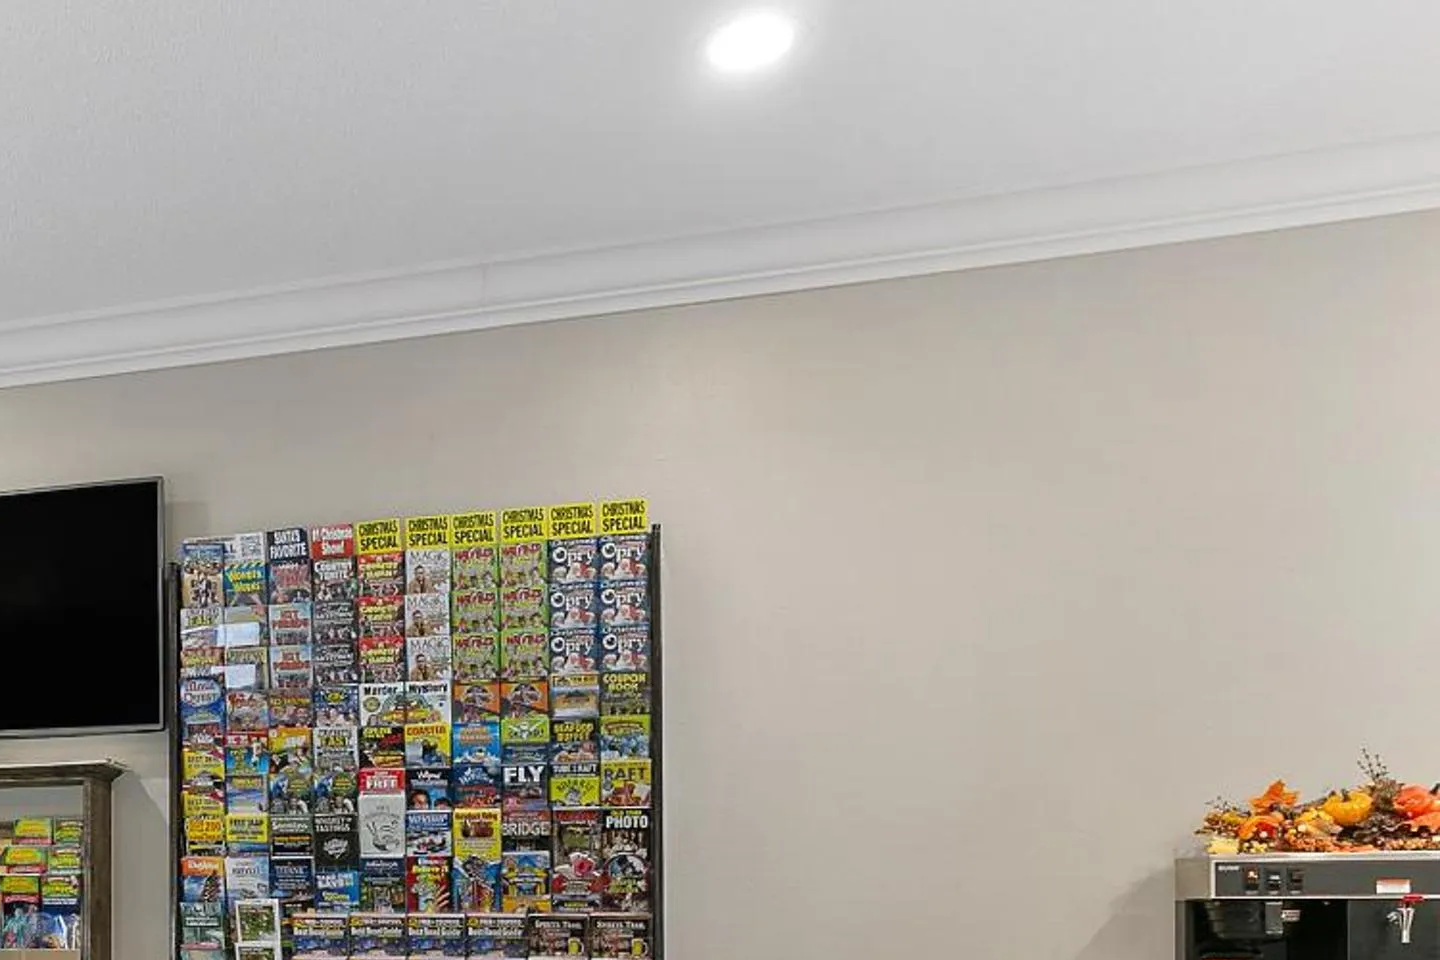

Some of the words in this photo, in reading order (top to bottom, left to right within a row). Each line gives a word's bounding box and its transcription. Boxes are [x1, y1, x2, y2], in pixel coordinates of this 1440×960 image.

[503, 509, 543, 524] CHRISTMAS
[551, 505, 592, 521] CHRISTMAS
[603, 500, 645, 517] CHRISTMAS
[358, 519, 398, 535] CHRISTMAS
[408, 517, 448, 532] CHRISTMAS
[453, 514, 494, 529] CHRISTMAS
[552, 519, 592, 536] SPECIAL
[603, 515, 643, 532] SPECIAL
[409, 531, 447, 547] SPECIAL
[455, 529, 494, 544] SPECIAL
[503, 523, 543, 539] SPECIAL
[360, 534, 397, 550] SPECIAL
[270, 543, 307, 560] FAVORITE
[552, 546, 594, 566] Opry
[602, 542, 646, 562] Opry
[551, 593, 593, 611] Opry
[601, 589, 646, 608] Opry
[551, 637, 592, 655] Opry
[602, 633, 646, 653] Opry
[603, 673, 646, 684] COUPON
[364, 686, 397, 696] Murder
[608, 683, 638, 692] BOOK
[407, 726, 446, 737] COASTER
[555, 723, 594, 732] SEAFOOD
[504, 766, 544, 783] FLY
[604, 767, 646, 780] RAFT
[502, 822, 550, 837] BRIDGE
[606, 815, 648, 829] PHOTO
